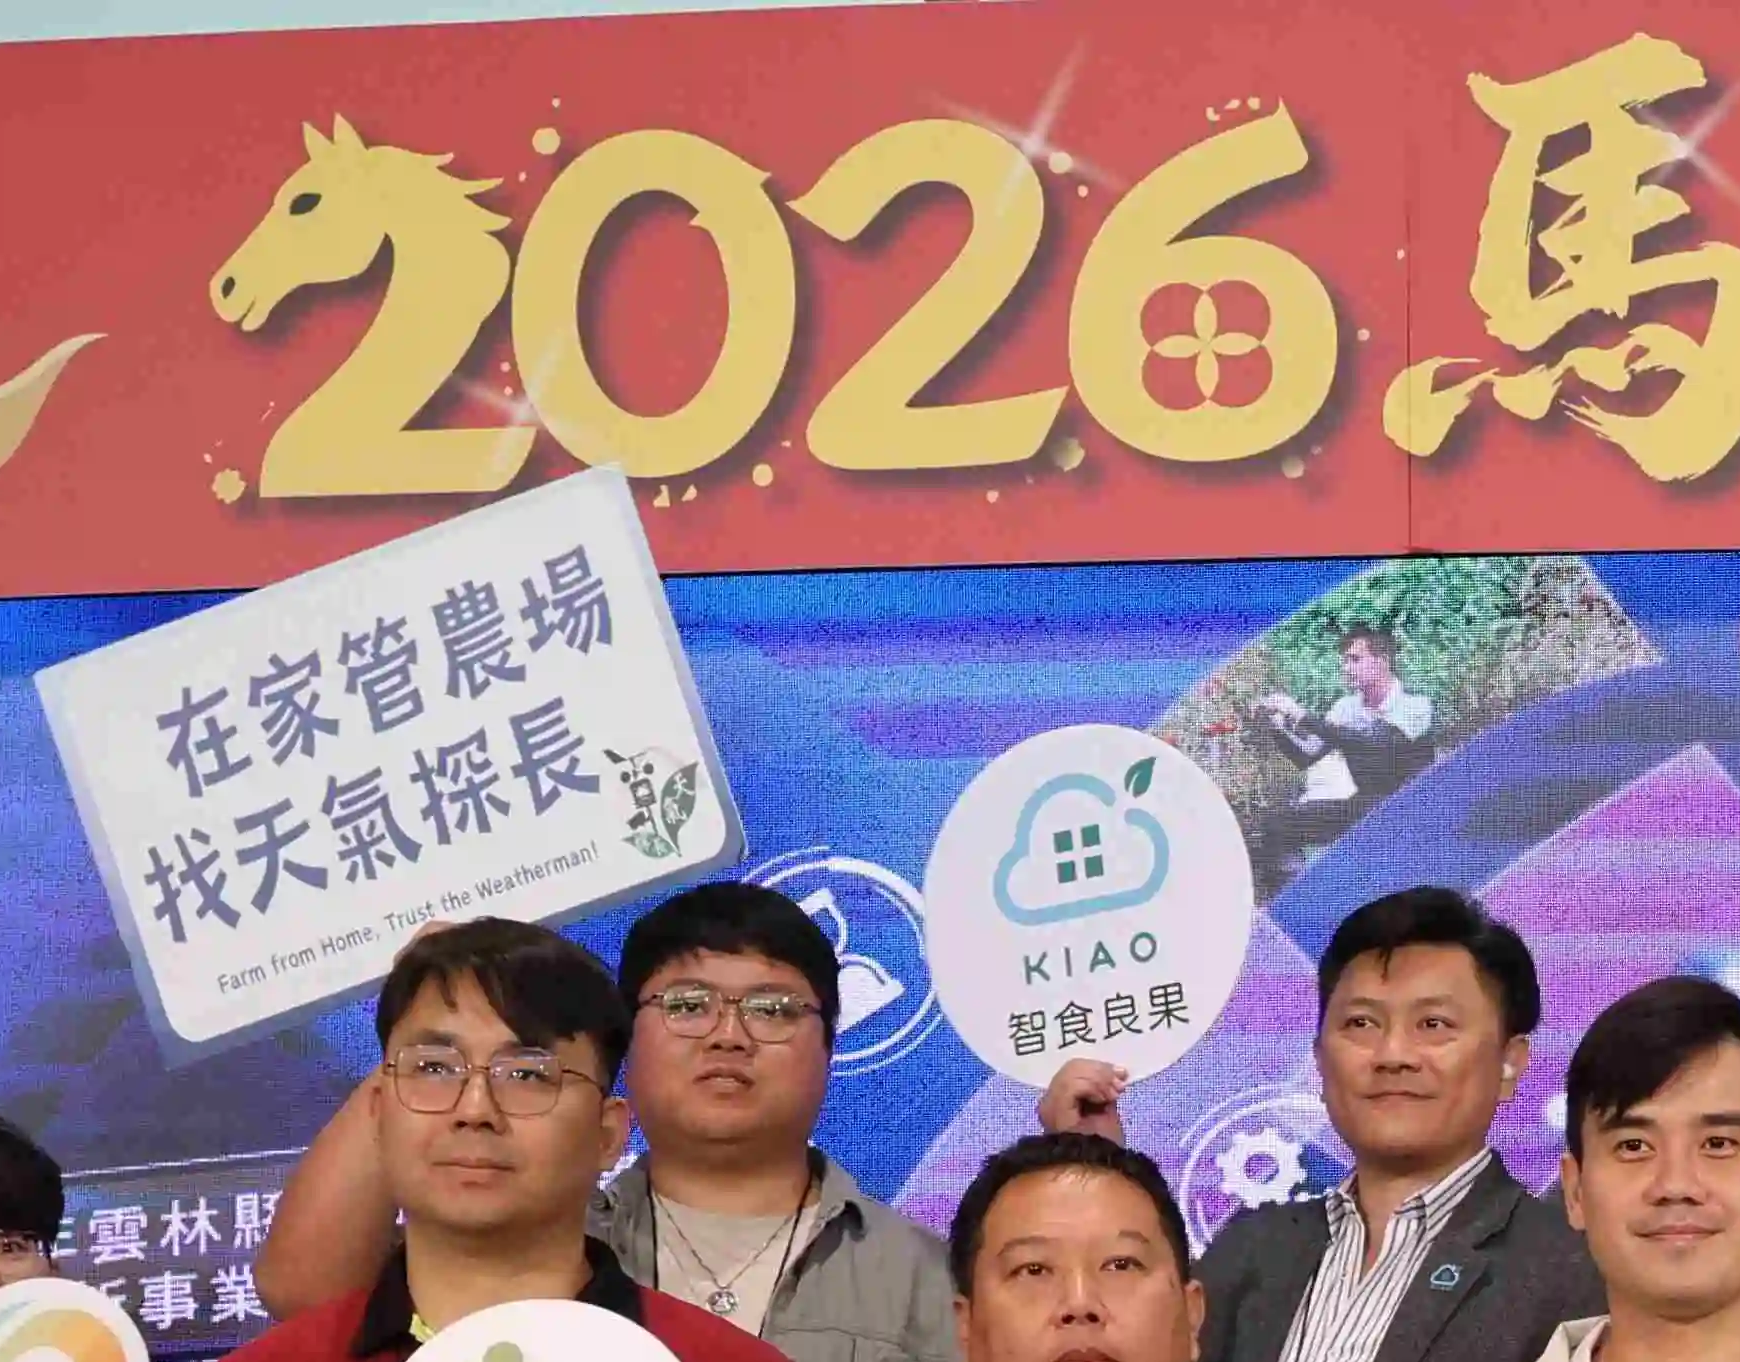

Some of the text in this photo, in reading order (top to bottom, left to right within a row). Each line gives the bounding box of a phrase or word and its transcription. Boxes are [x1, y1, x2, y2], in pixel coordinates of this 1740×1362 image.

[205, 95, 1345, 502] 2026
[157, 542, 614, 797] 在家管農場
[142, 697, 601, 944] 找天氣探長
[217, 840, 599, 994] Farm from Home, Trust the Weatherman!
[1023, 930, 1160, 985] KIAO
[1004, 982, 1193, 1060] 智食良果
[100, 1262, 268, 1331] 事業
